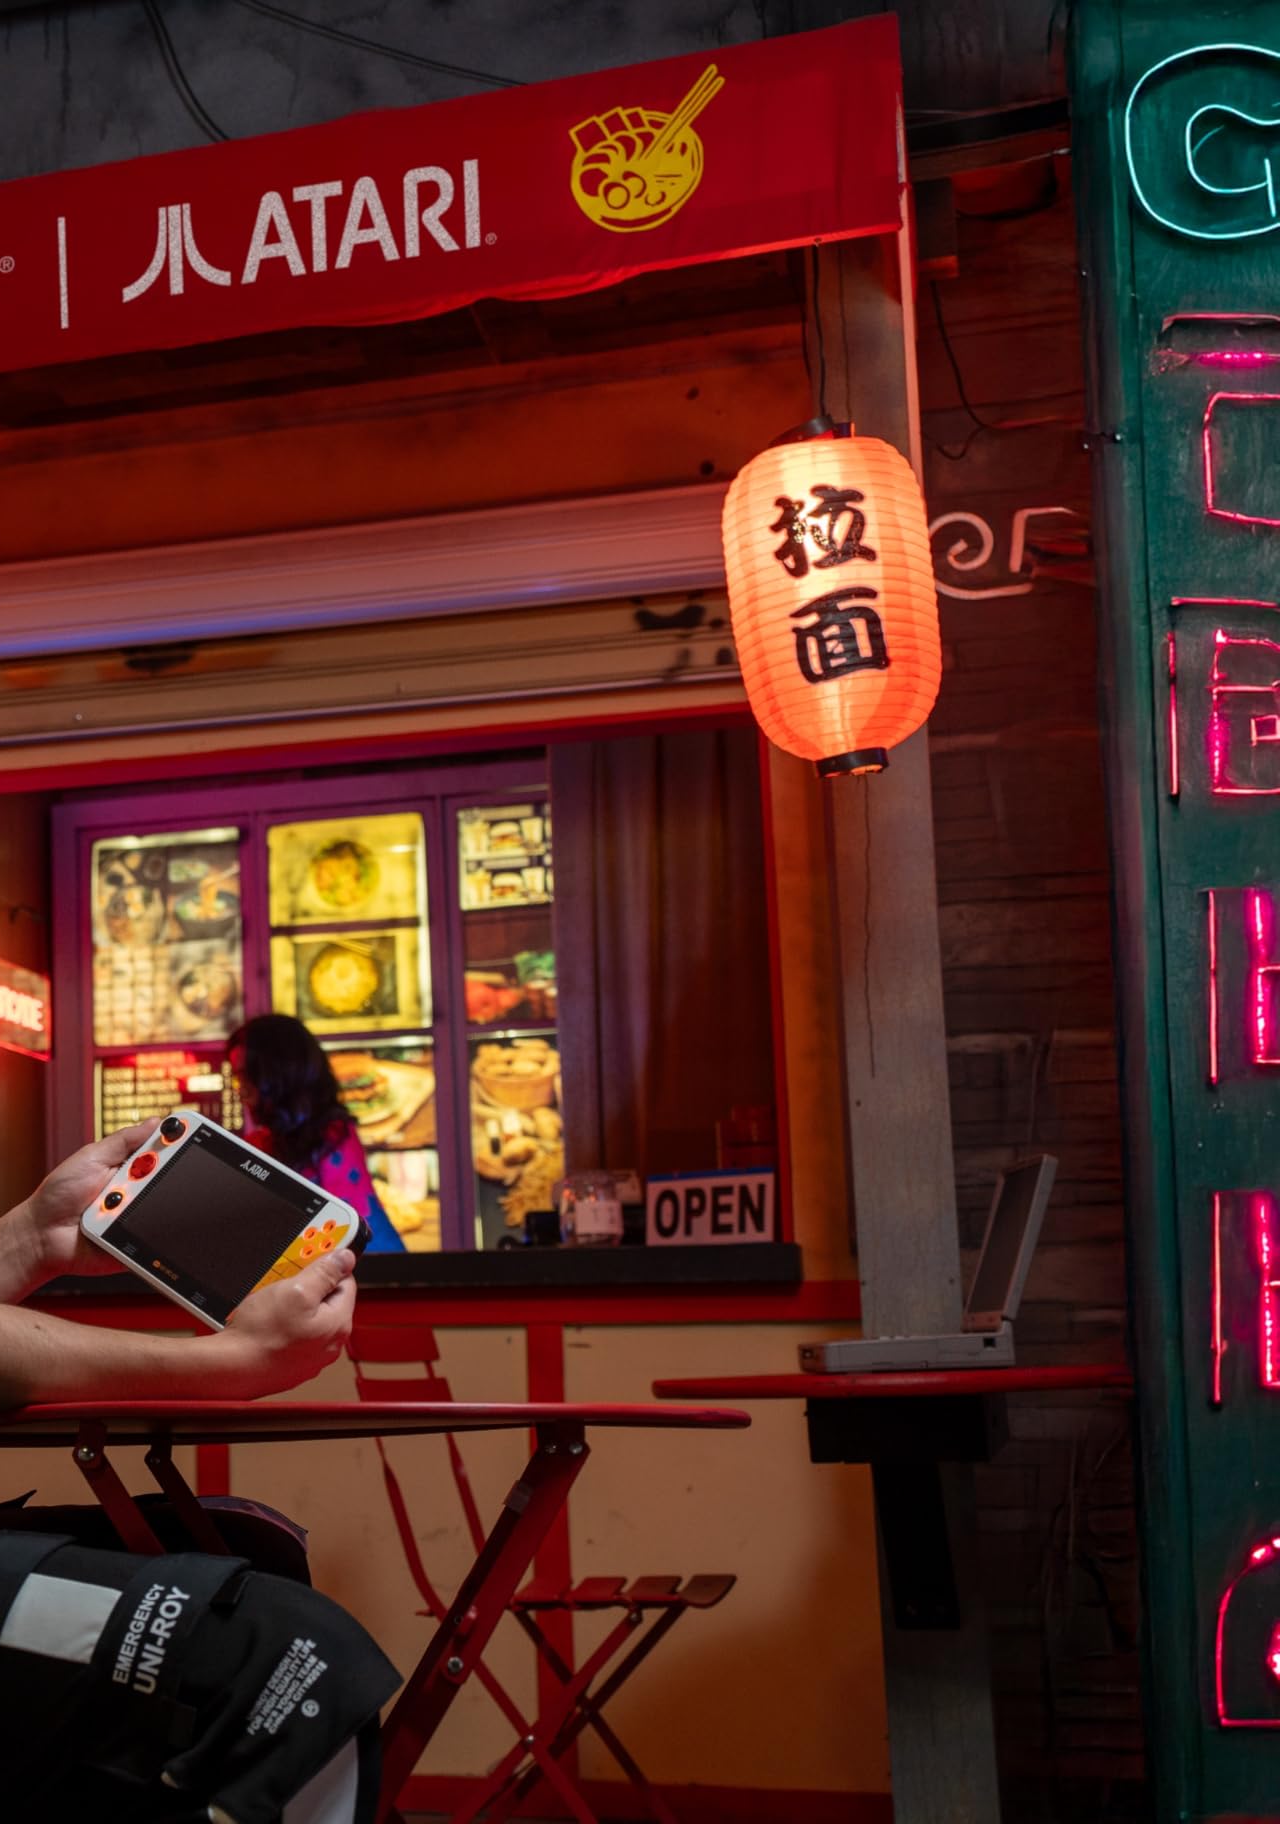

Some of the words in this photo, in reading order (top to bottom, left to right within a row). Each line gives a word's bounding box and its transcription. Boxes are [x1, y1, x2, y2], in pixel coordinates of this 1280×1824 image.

[247, 1163, 271, 1182] ATARI
[654, 1183, 766, 1239] OPEN
[112, 1583, 166, 1685] EMERGENCY
[132, 1585, 191, 1695] UNI-ROY
[287, 1638, 304, 1658] LAB
[247, 1715, 264, 1735] FOR
[275, 1657, 302, 1695] QUALITY
[298, 1639, 317, 1660] LIFE
[276, 1679, 300, 1710] YOUNG
[296, 1653, 318, 1680] TEAM
